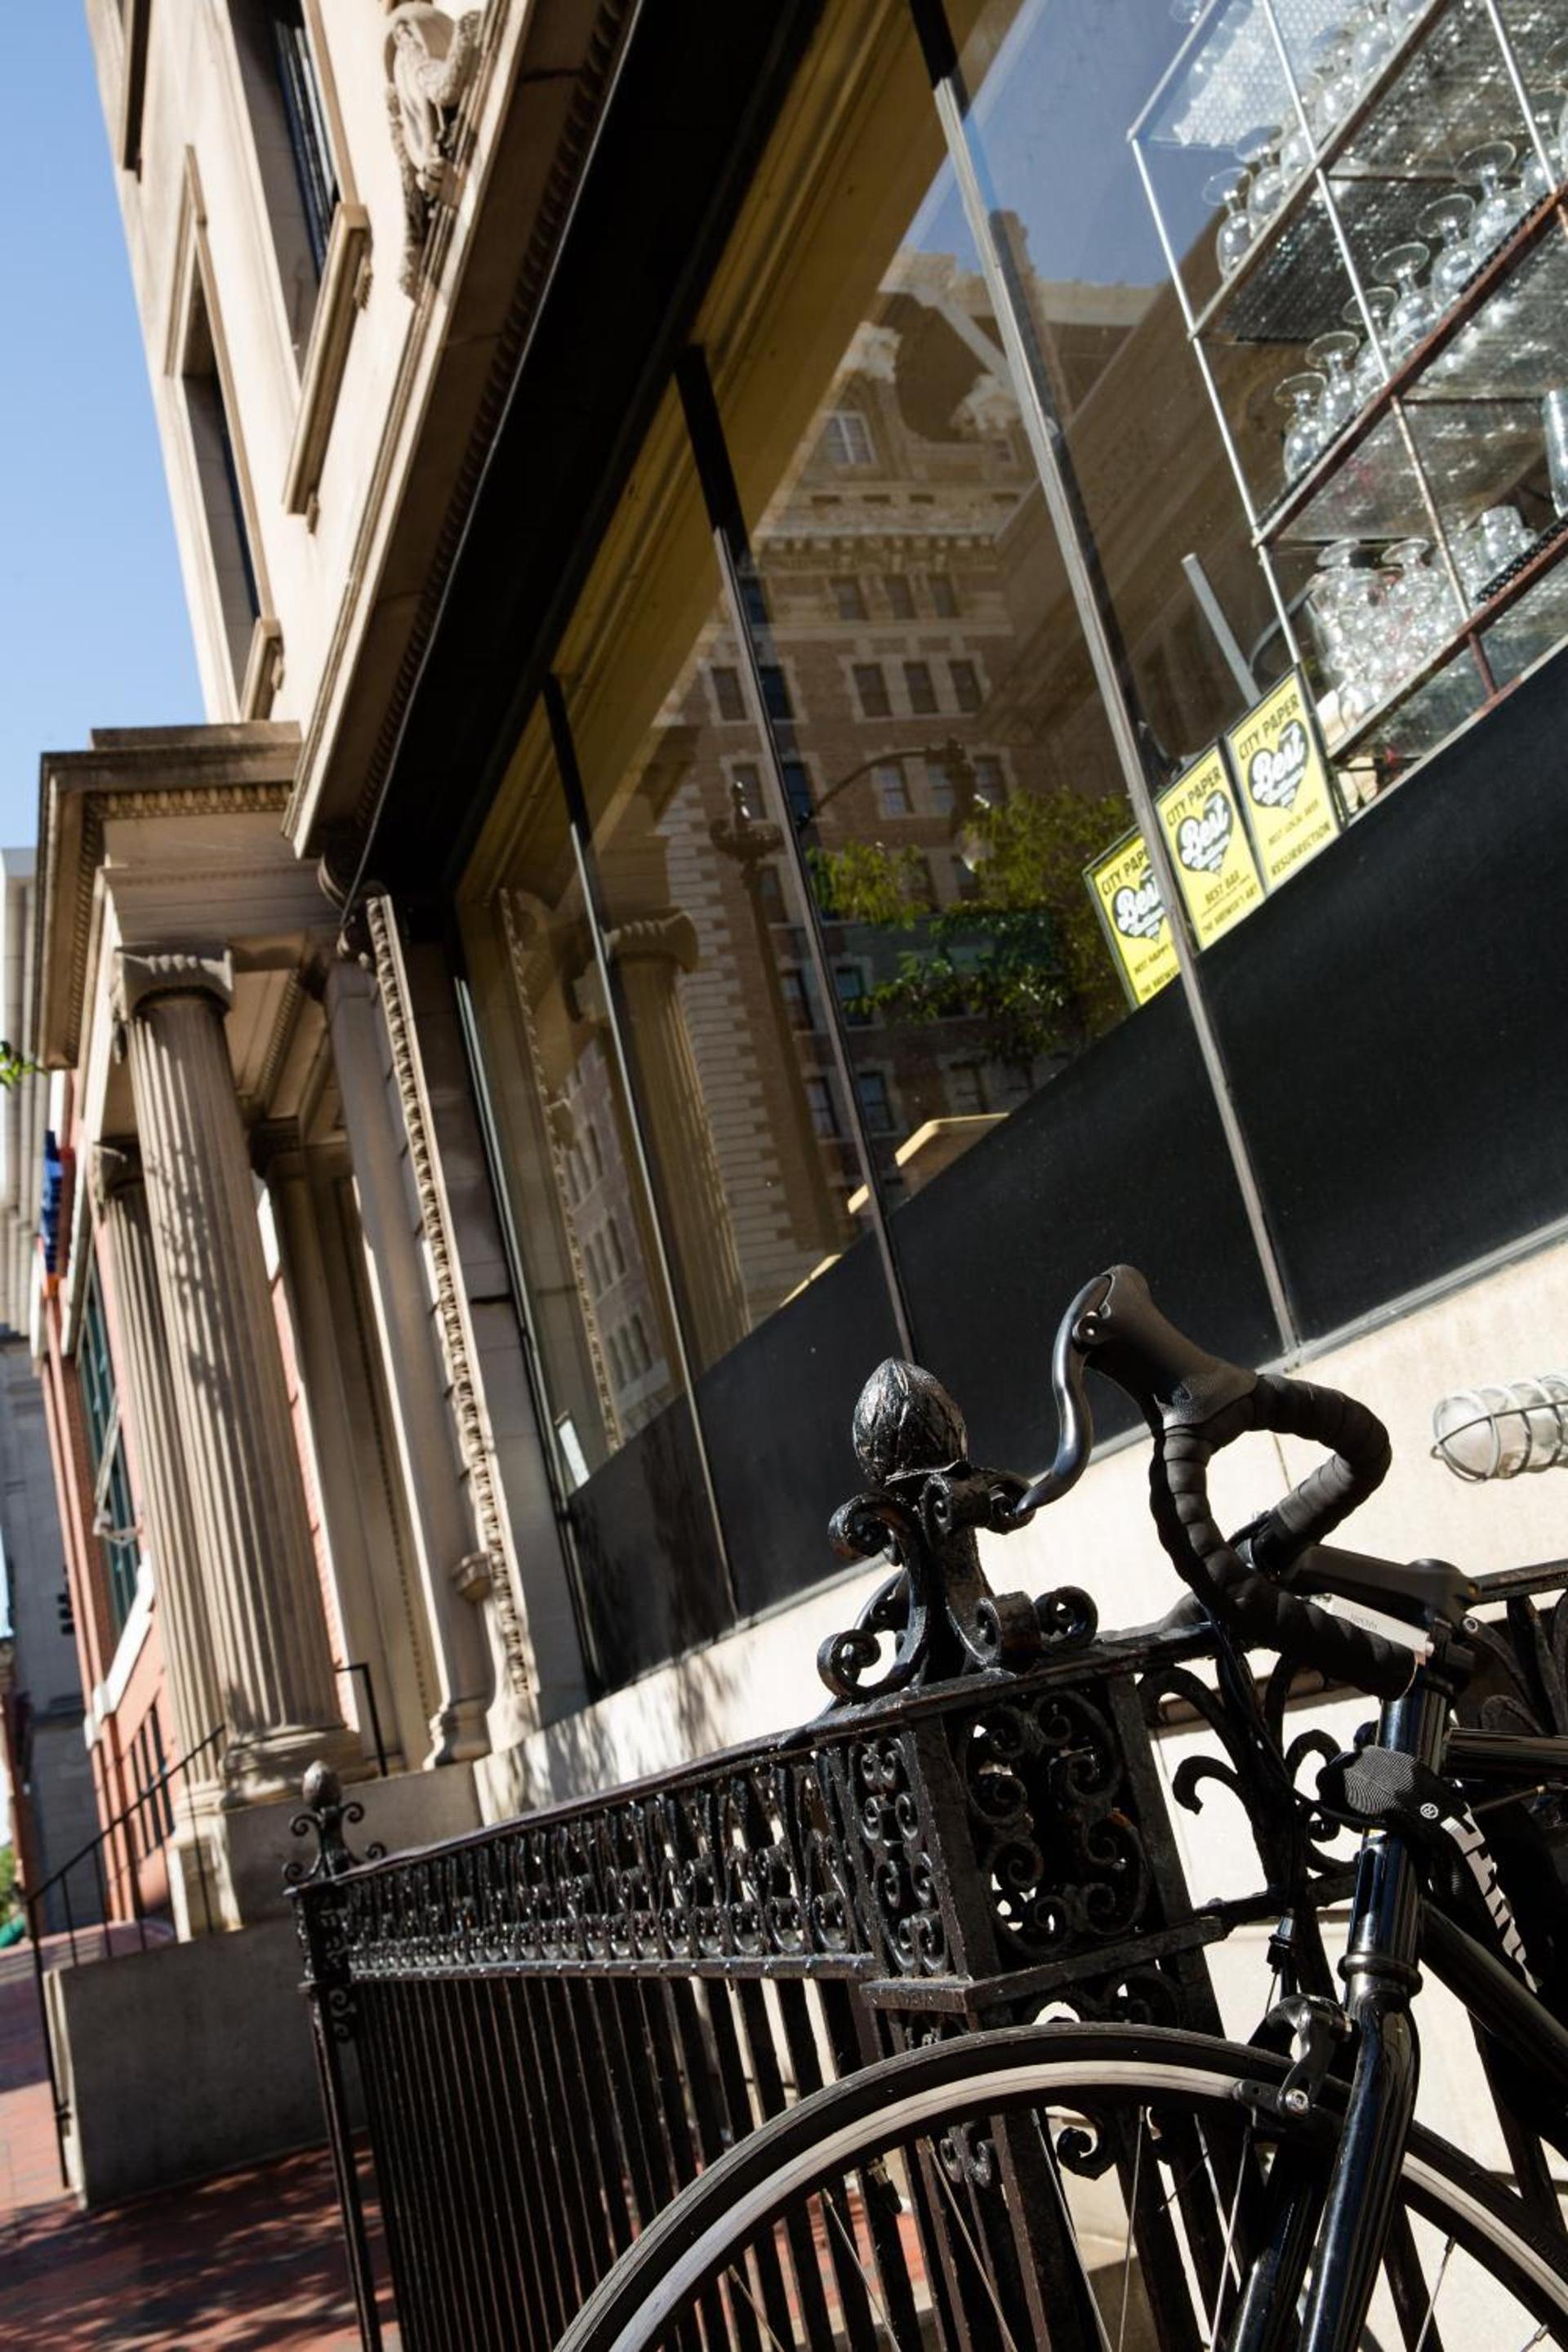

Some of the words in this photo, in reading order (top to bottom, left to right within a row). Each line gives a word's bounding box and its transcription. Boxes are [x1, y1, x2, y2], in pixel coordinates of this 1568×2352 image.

[1238, 730, 1260, 760] CITY
[1262, 693, 1299, 737] PAPER
[1165, 799, 1187, 826] CITY
[1187, 765, 1221, 806] PAPER
[1101, 870, 1122, 895] CITY
[1122, 845, 1150, 877] PAP
